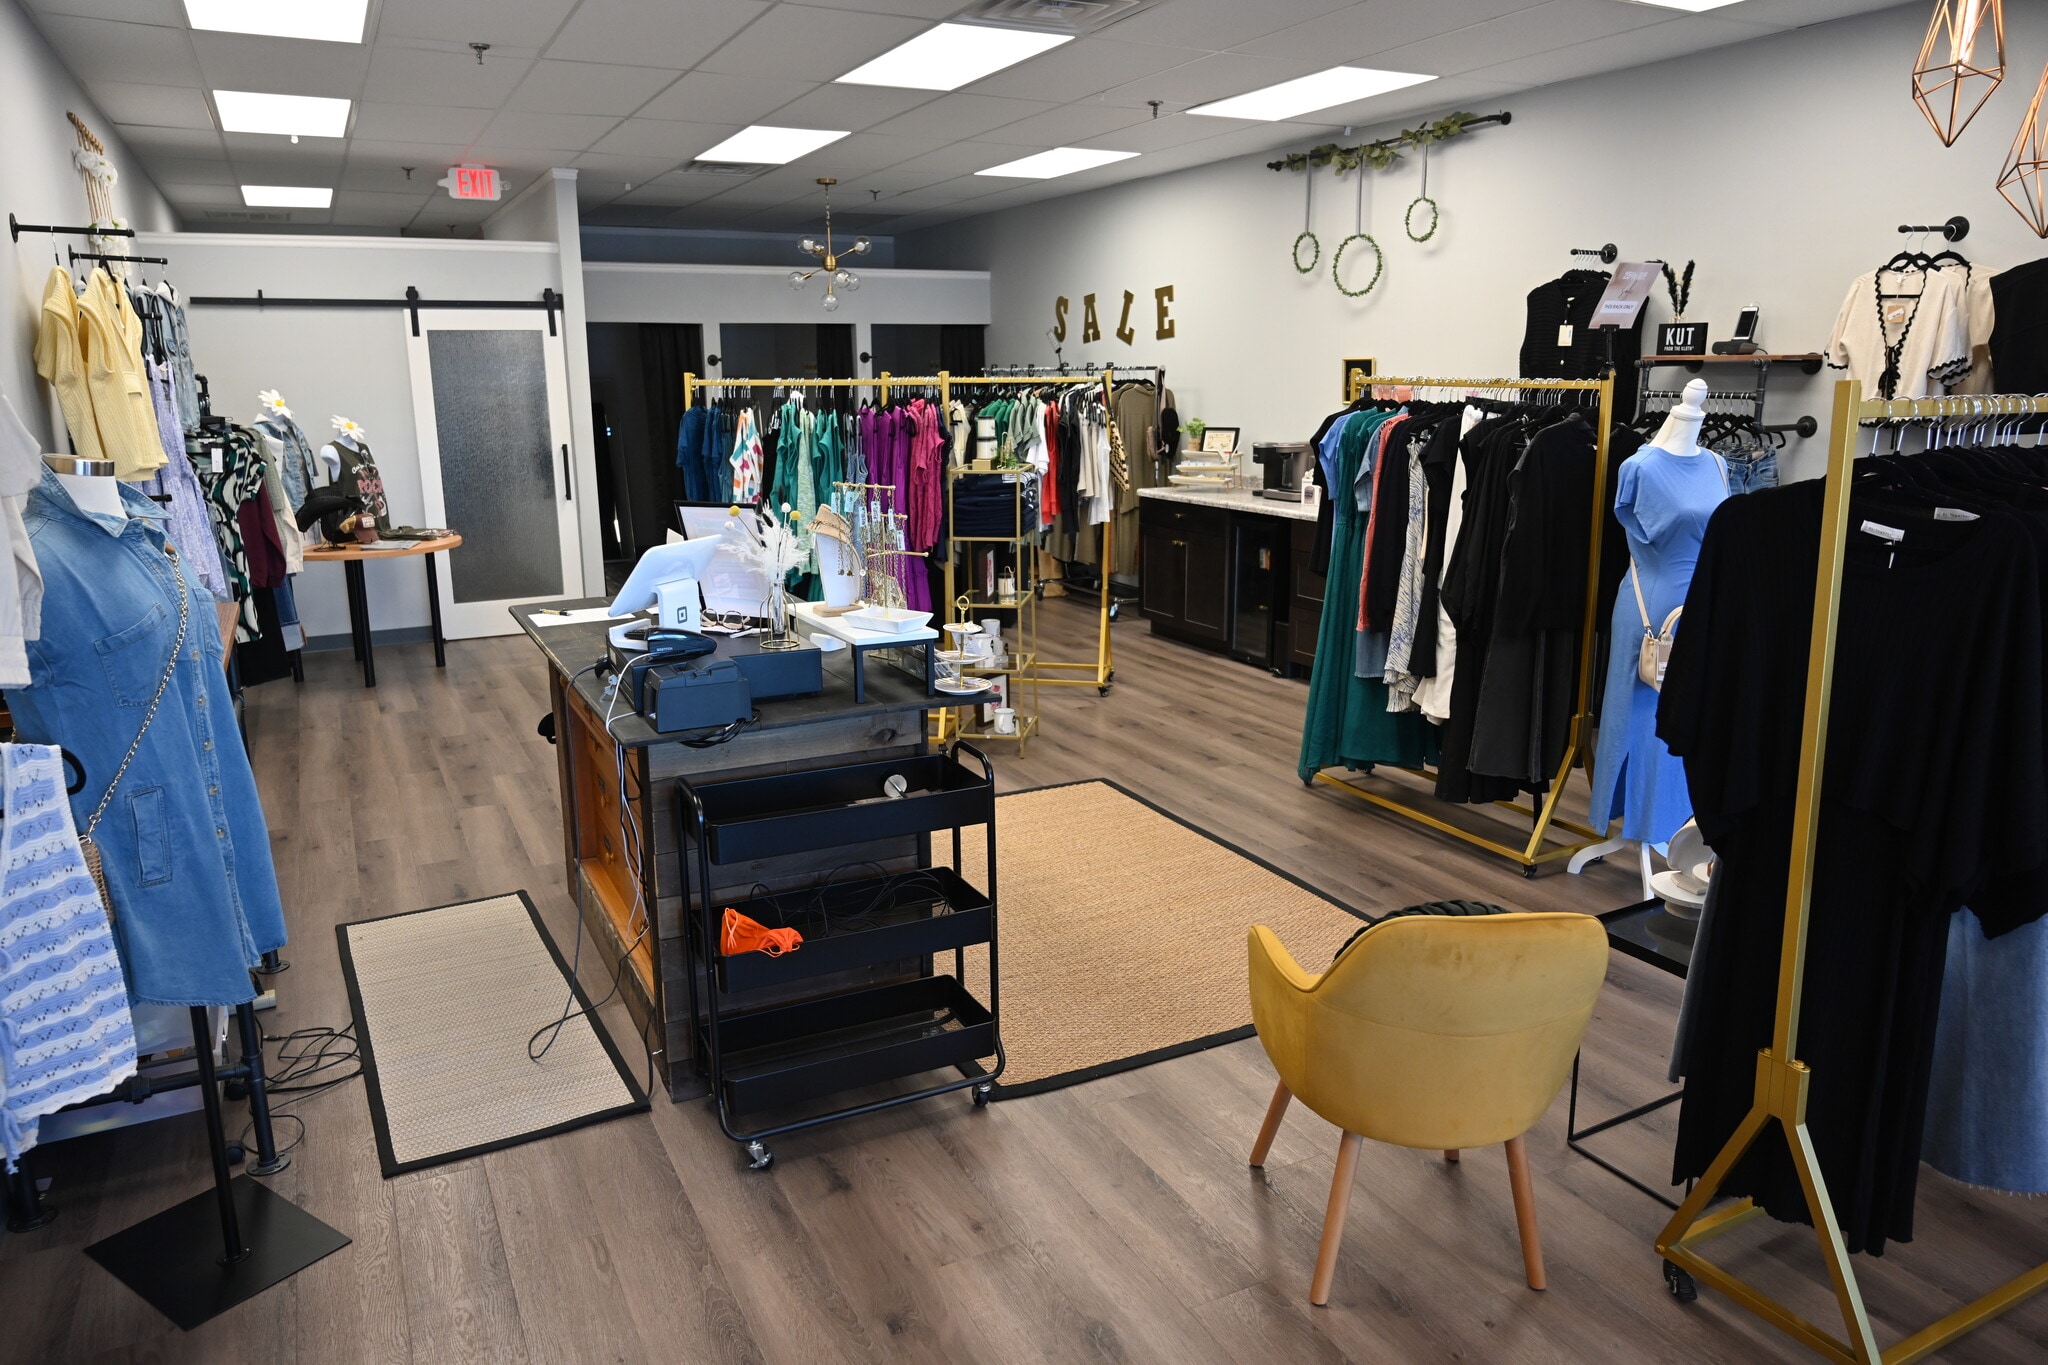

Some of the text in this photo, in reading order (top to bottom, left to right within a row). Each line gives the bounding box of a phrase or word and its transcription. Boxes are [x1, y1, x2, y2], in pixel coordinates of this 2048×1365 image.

[457, 169, 494, 199] EXIT
[1054, 284, 1176, 346] SALE
[1665, 327, 1695, 346] KUT
